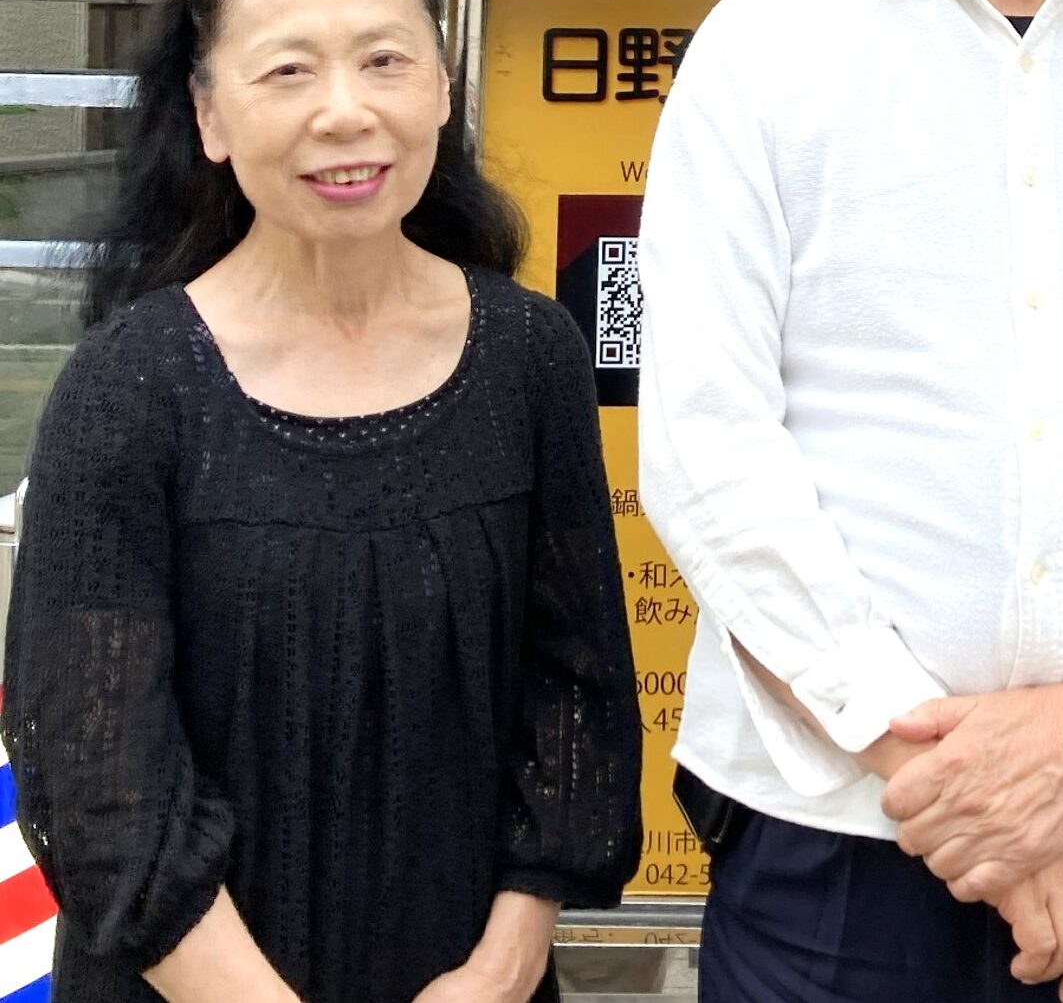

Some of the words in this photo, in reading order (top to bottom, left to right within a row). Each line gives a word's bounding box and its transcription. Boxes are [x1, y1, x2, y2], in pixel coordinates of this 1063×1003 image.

[612, 488, 645, 517] 鍋
[635, 596, 699, 626] 飲み
[642, 830, 704, 855] 川市
